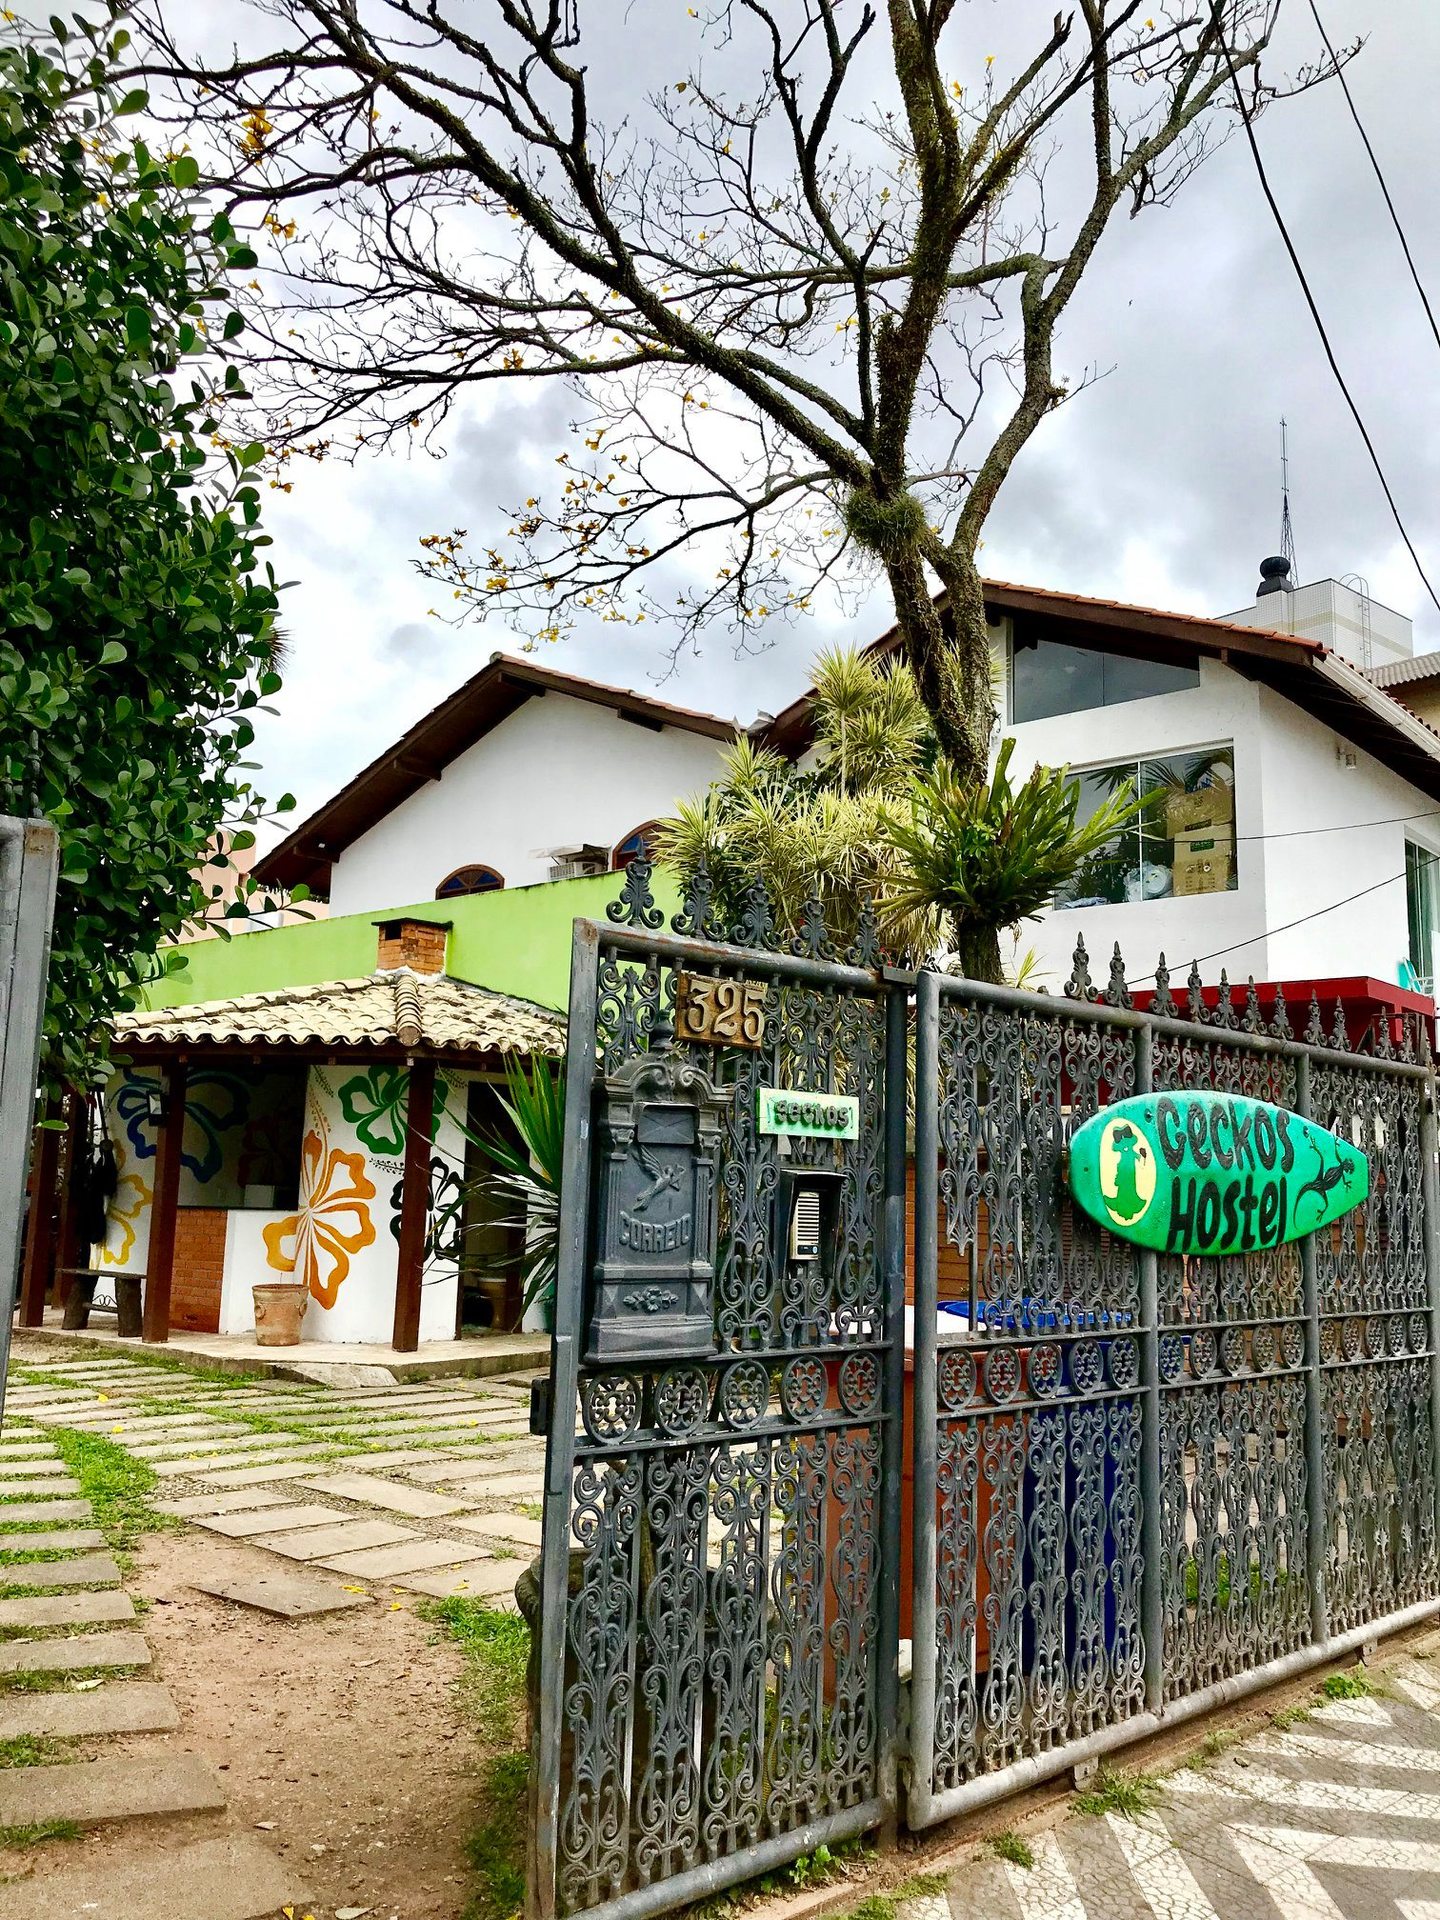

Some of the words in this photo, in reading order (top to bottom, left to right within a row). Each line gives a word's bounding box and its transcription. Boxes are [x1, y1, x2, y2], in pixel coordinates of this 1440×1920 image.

[689, 979, 766, 1041] 325
[619, 1211, 691, 1253] CORREIO
[1165, 1174, 1288, 1251] Hostel
